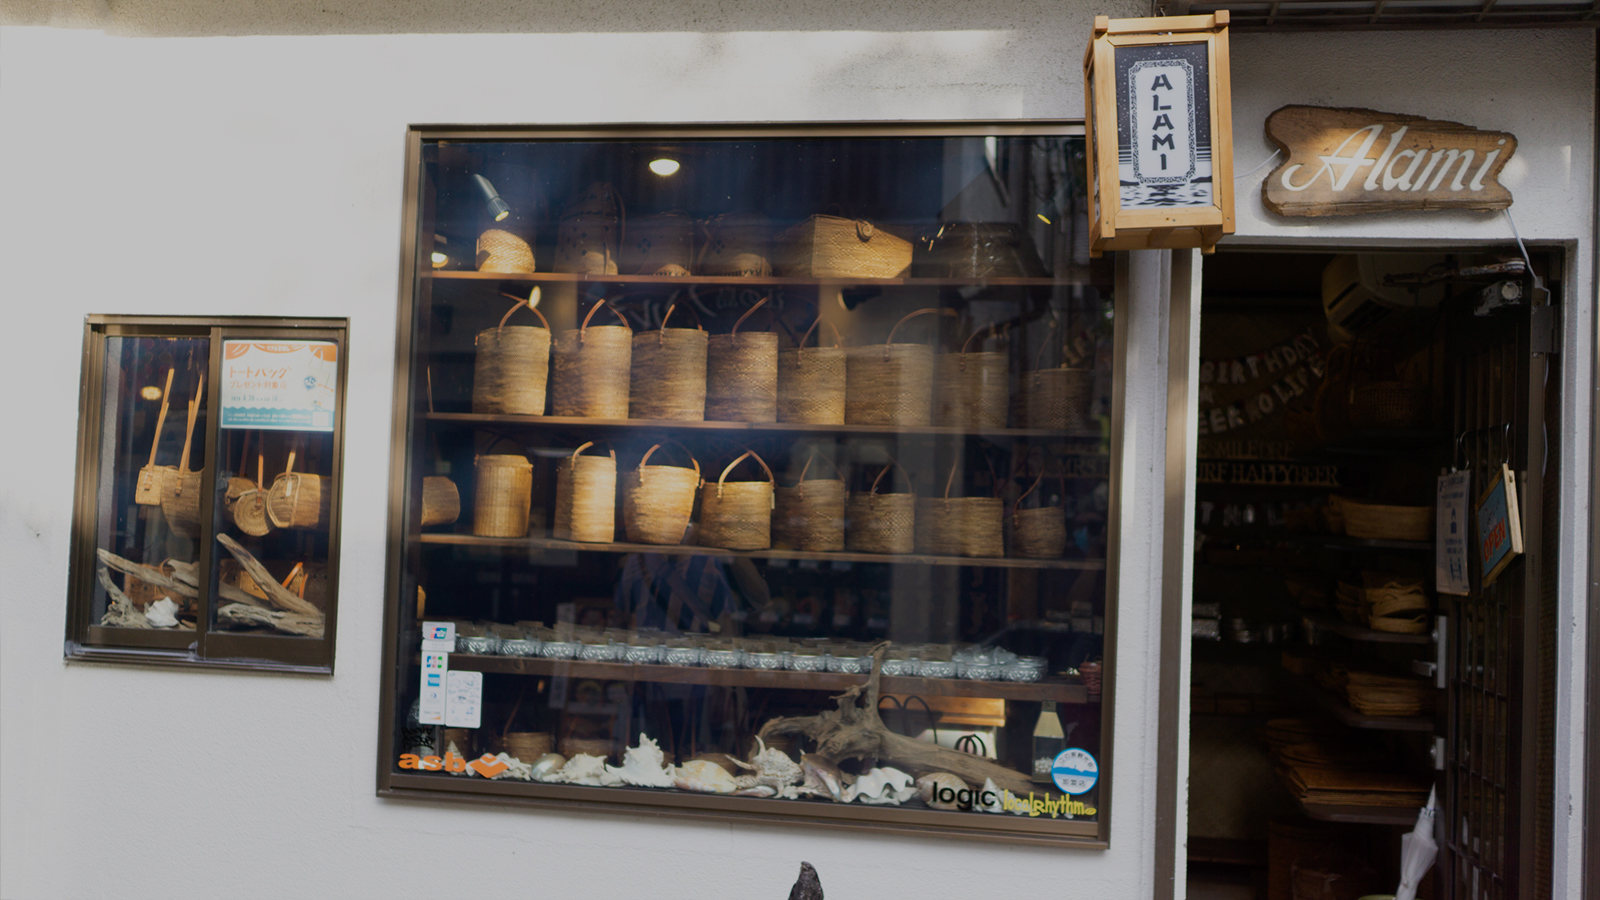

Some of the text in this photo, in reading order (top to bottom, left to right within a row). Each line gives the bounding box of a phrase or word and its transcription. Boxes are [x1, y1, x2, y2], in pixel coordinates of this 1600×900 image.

[1150, 73, 1175, 172] ALAMI
[1280, 123, 1507, 194] Alami
[229, 365, 292, 379] トートバッグ
[1483, 517, 1507, 564] OPEN
[397, 752, 467, 773] asb
[932, 781, 997, 811] logic
